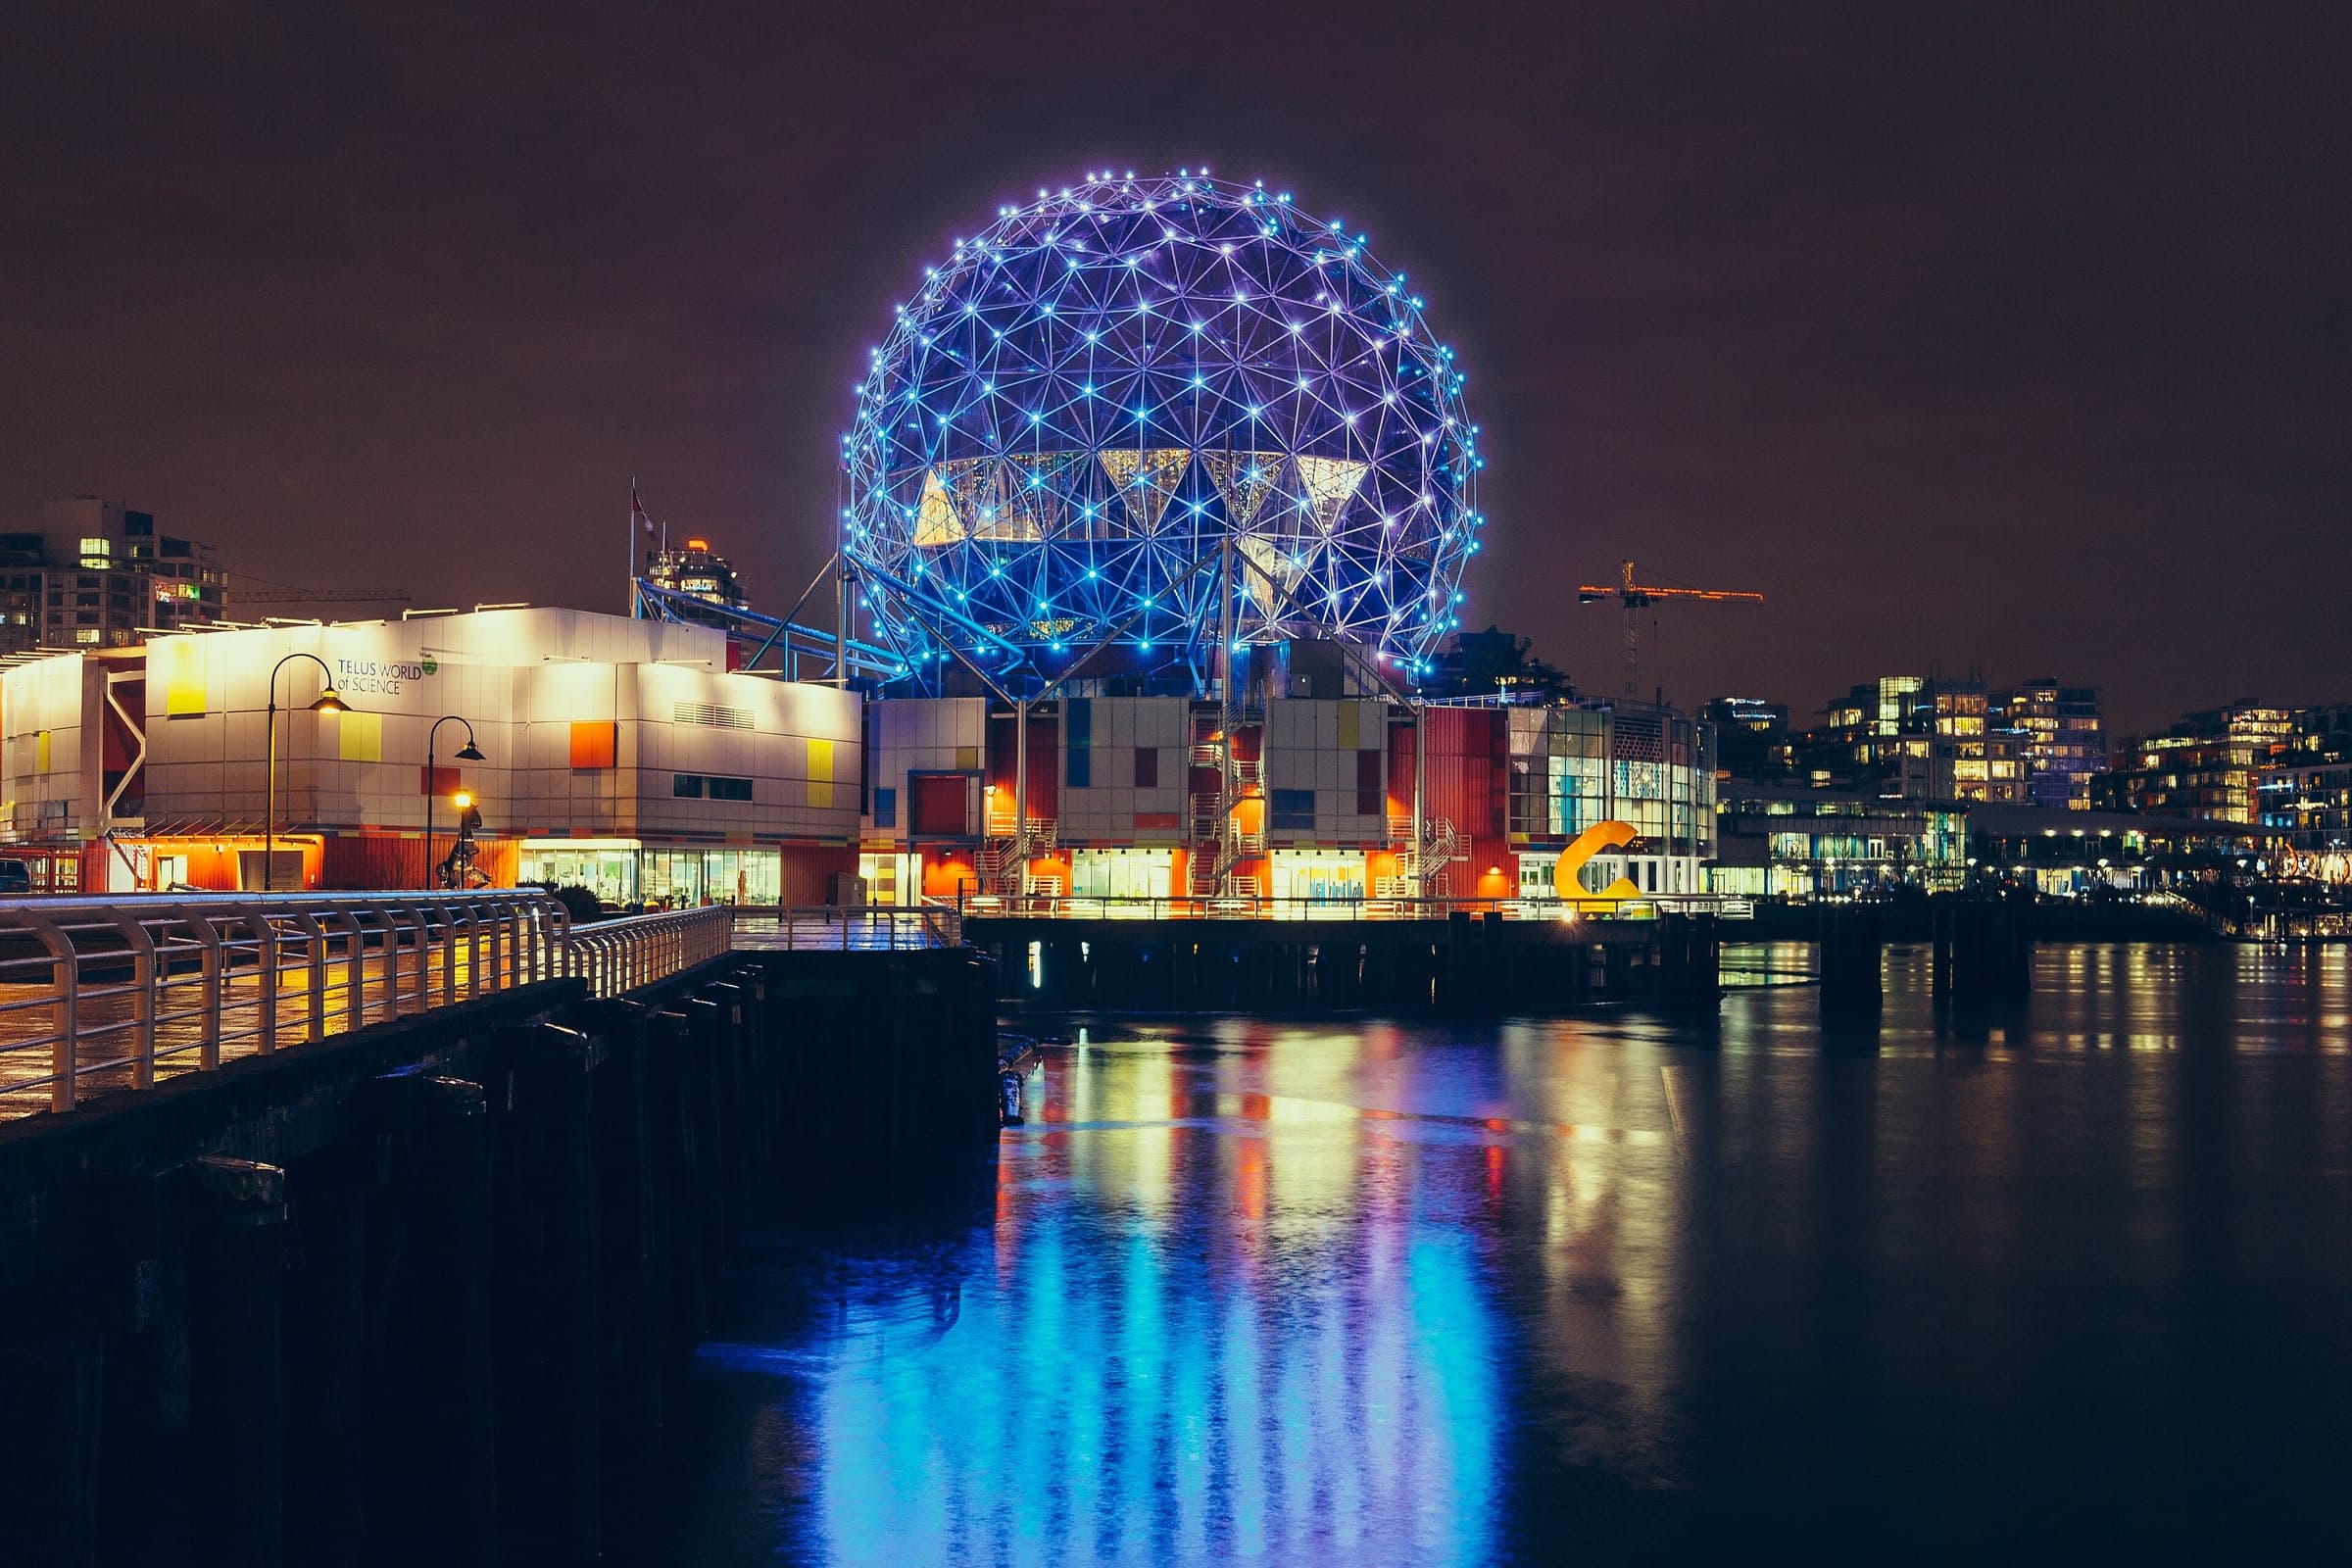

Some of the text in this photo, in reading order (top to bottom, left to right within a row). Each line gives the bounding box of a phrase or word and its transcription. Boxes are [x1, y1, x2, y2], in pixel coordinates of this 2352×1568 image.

[338, 660, 421, 680] TELUS WORLD
[337, 676, 401, 695] of SCIENCE
